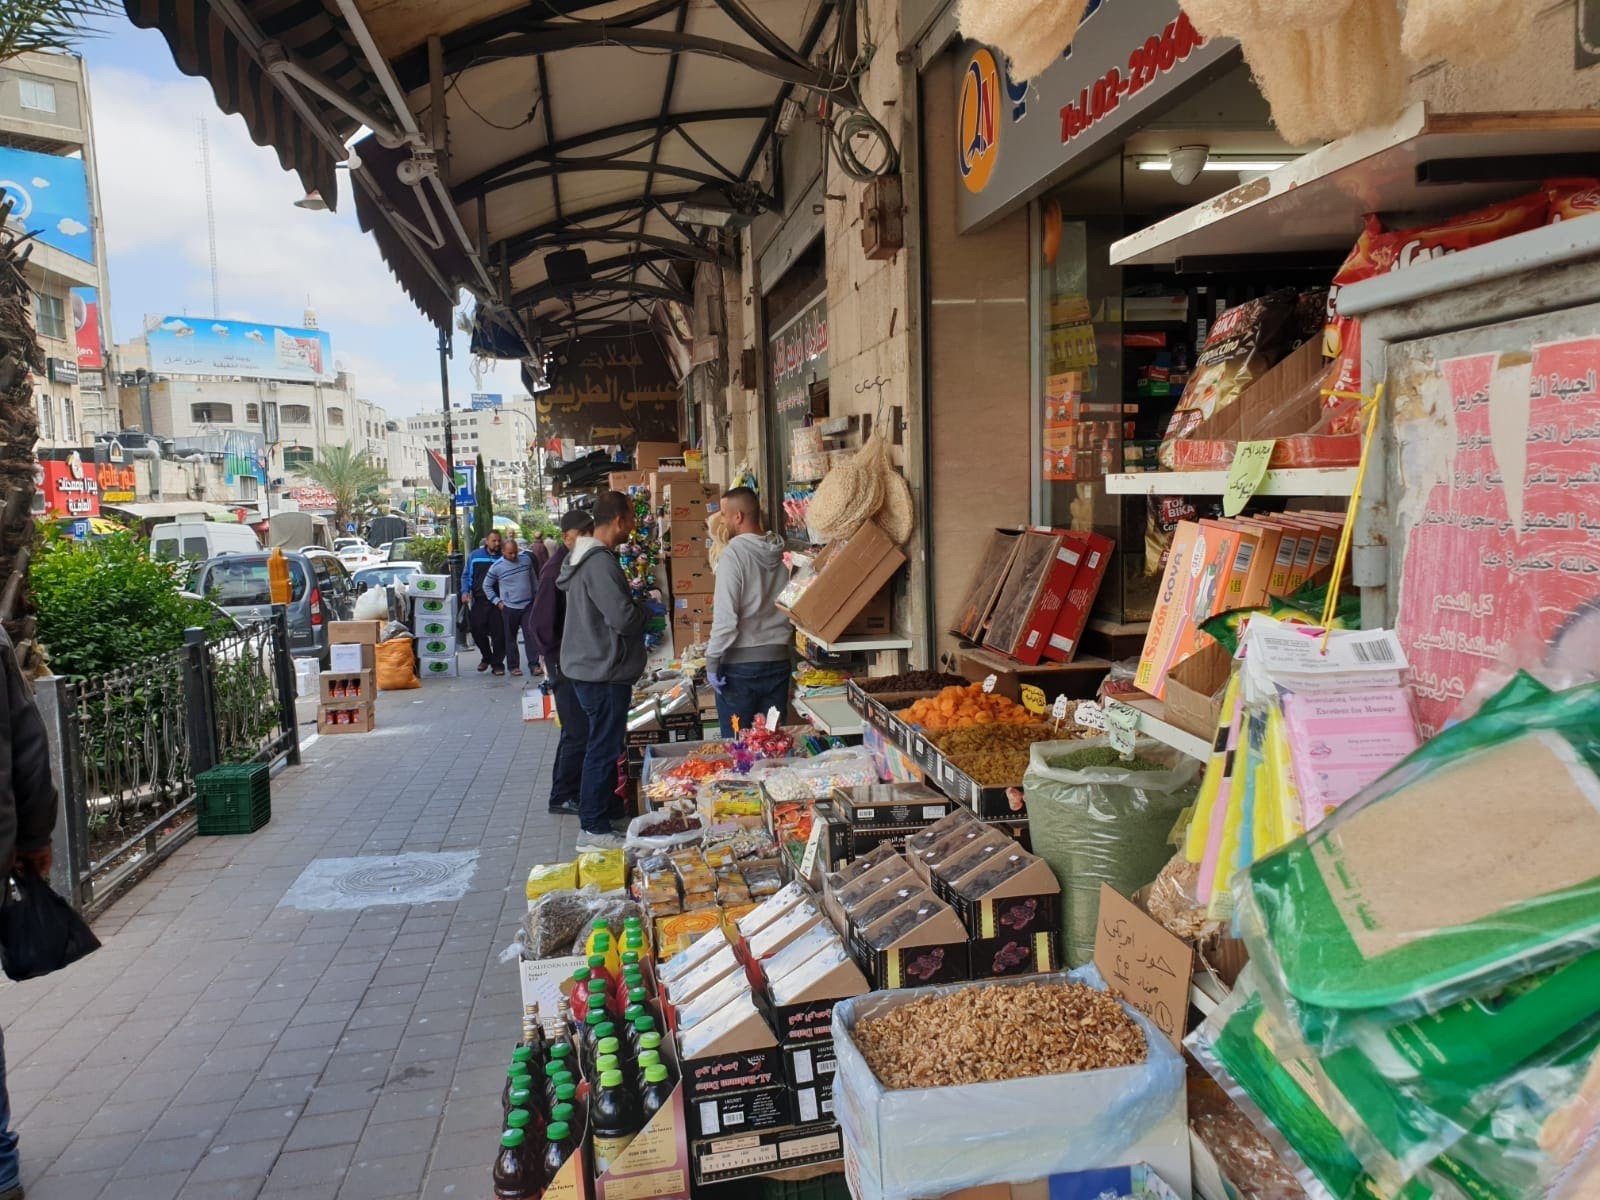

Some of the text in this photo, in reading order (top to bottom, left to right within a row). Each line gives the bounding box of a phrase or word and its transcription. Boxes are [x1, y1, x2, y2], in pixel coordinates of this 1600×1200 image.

[1168, 505, 1195, 518] BIKA
[1163, 551, 1183, 603] GOYA
[1144, 604, 1169, 658] Sazón
